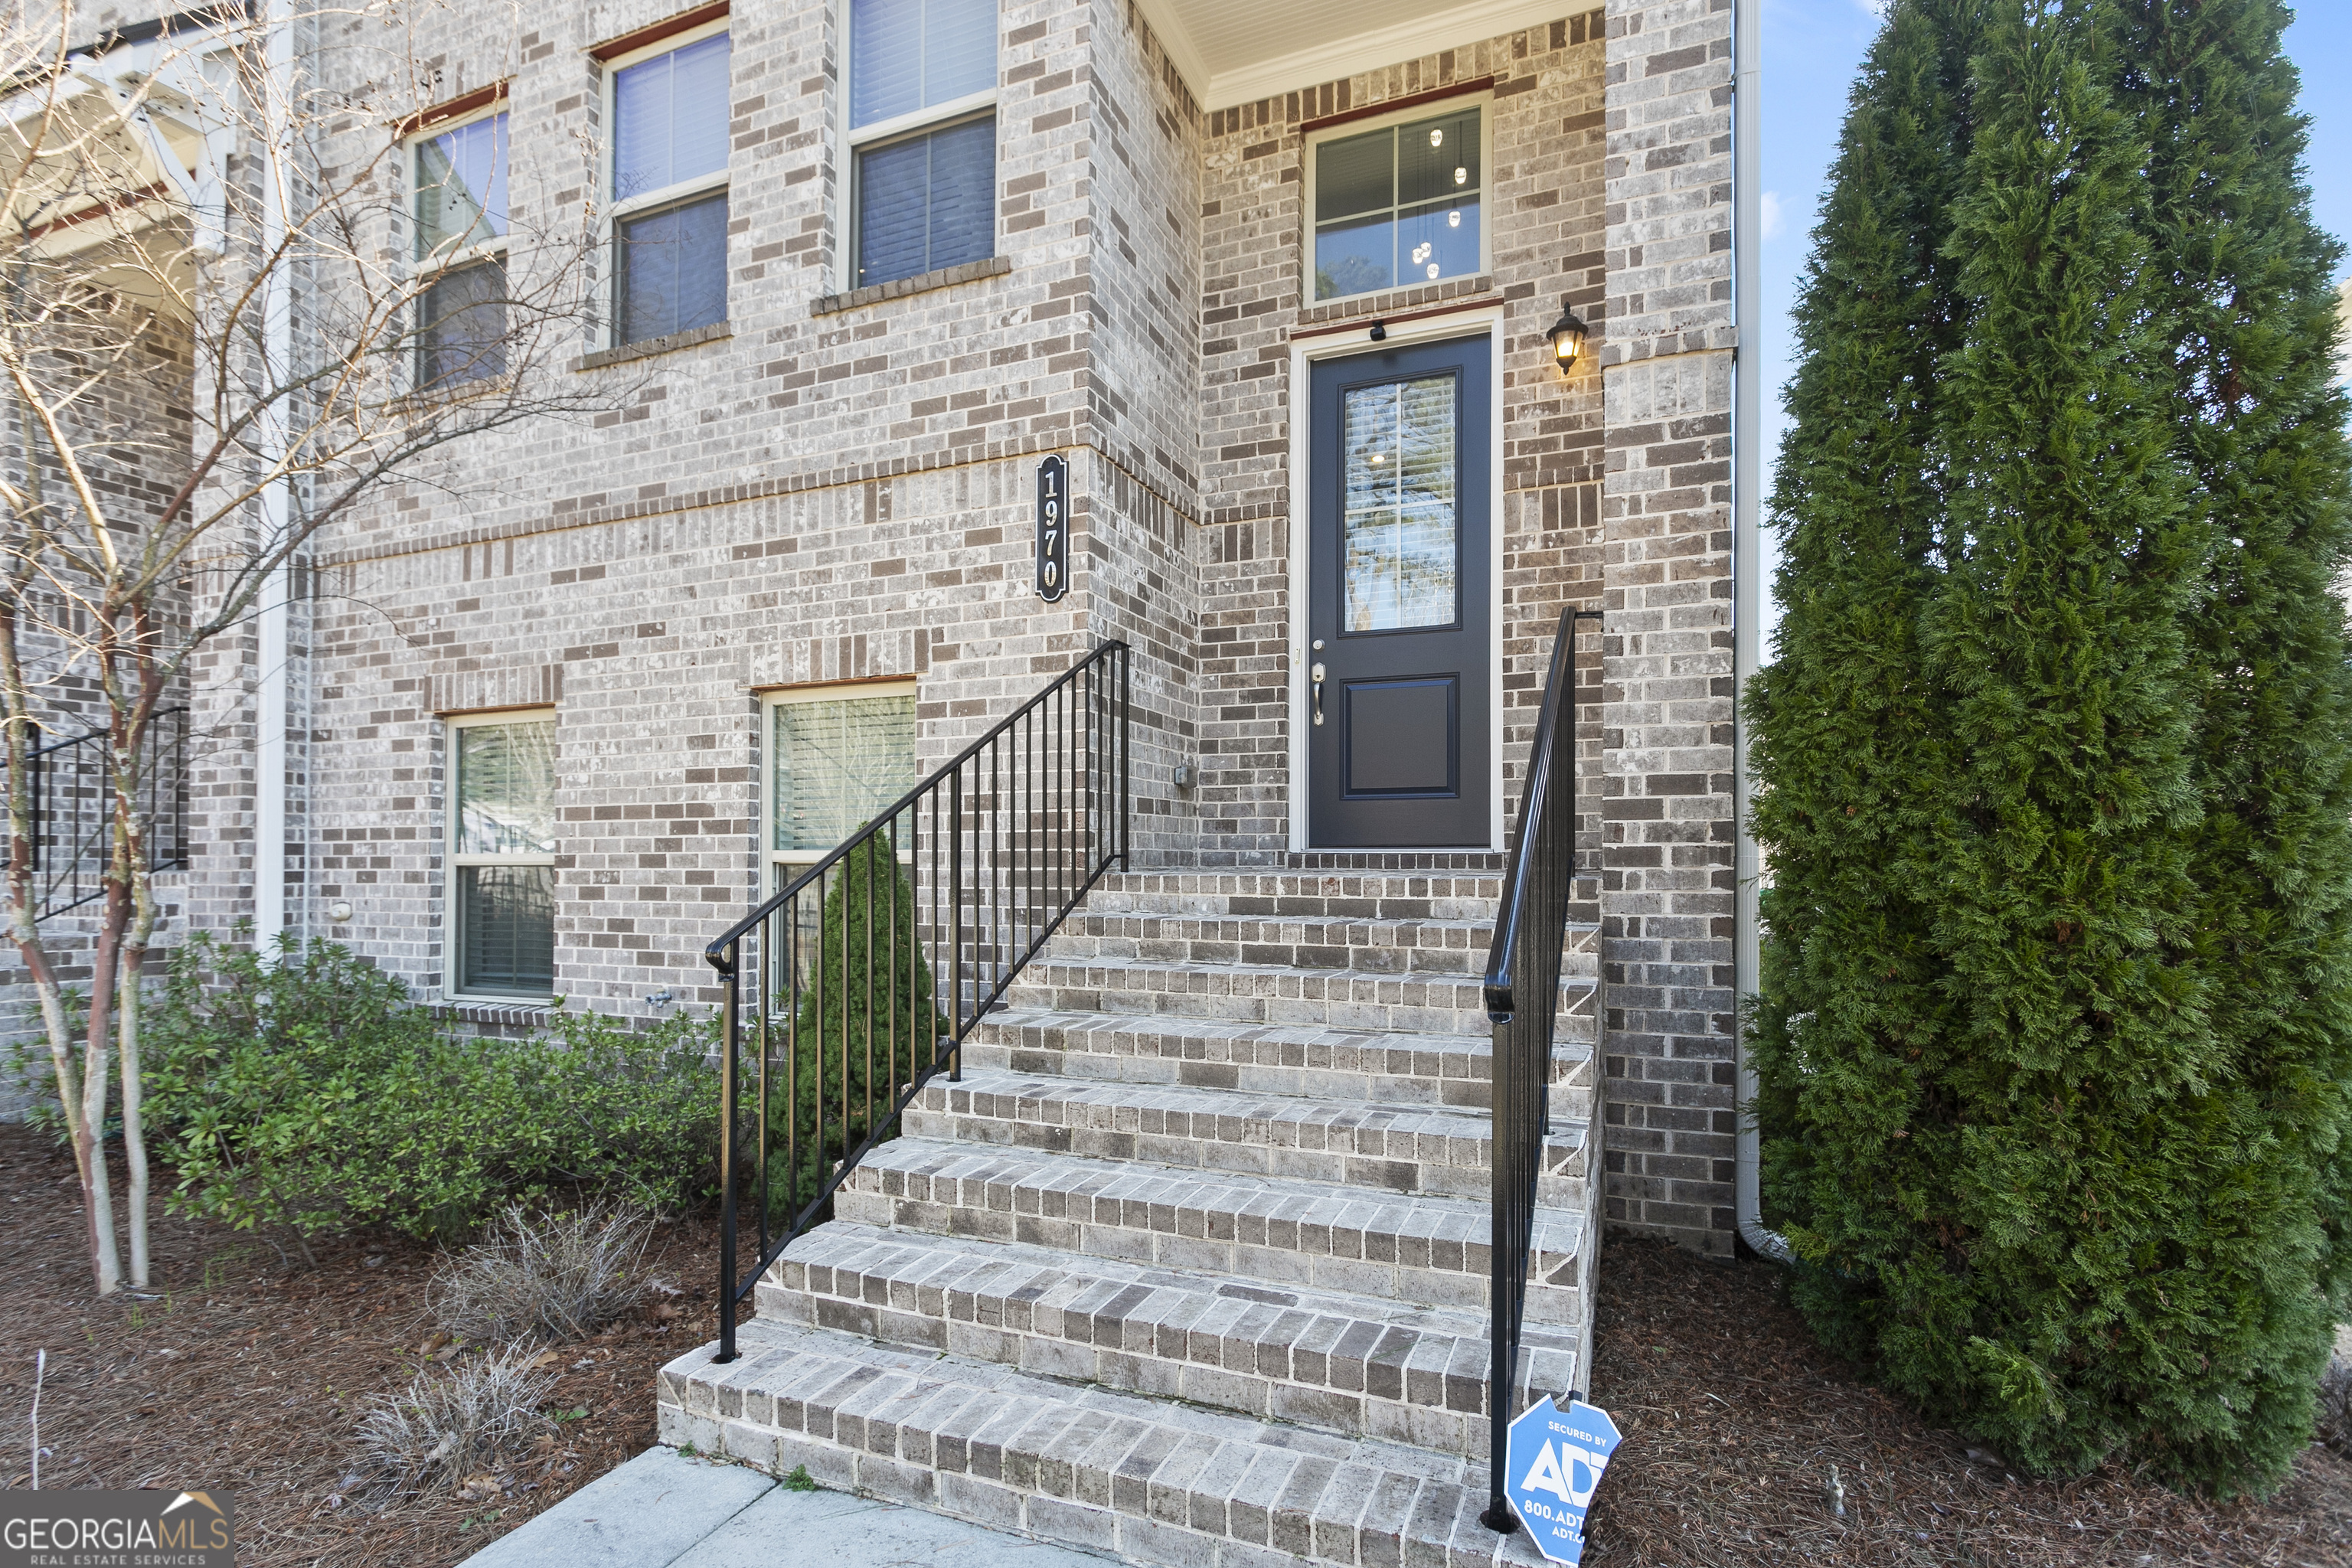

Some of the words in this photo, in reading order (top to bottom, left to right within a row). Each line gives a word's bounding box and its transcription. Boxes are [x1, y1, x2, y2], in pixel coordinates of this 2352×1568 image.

[1044, 471, 1057, 587] 1970
[1547, 1420, 1592, 1442] SECURED
[1594, 1436, 1607, 1447] BY
[1552, 1525, 1586, 1544] ADT.C
